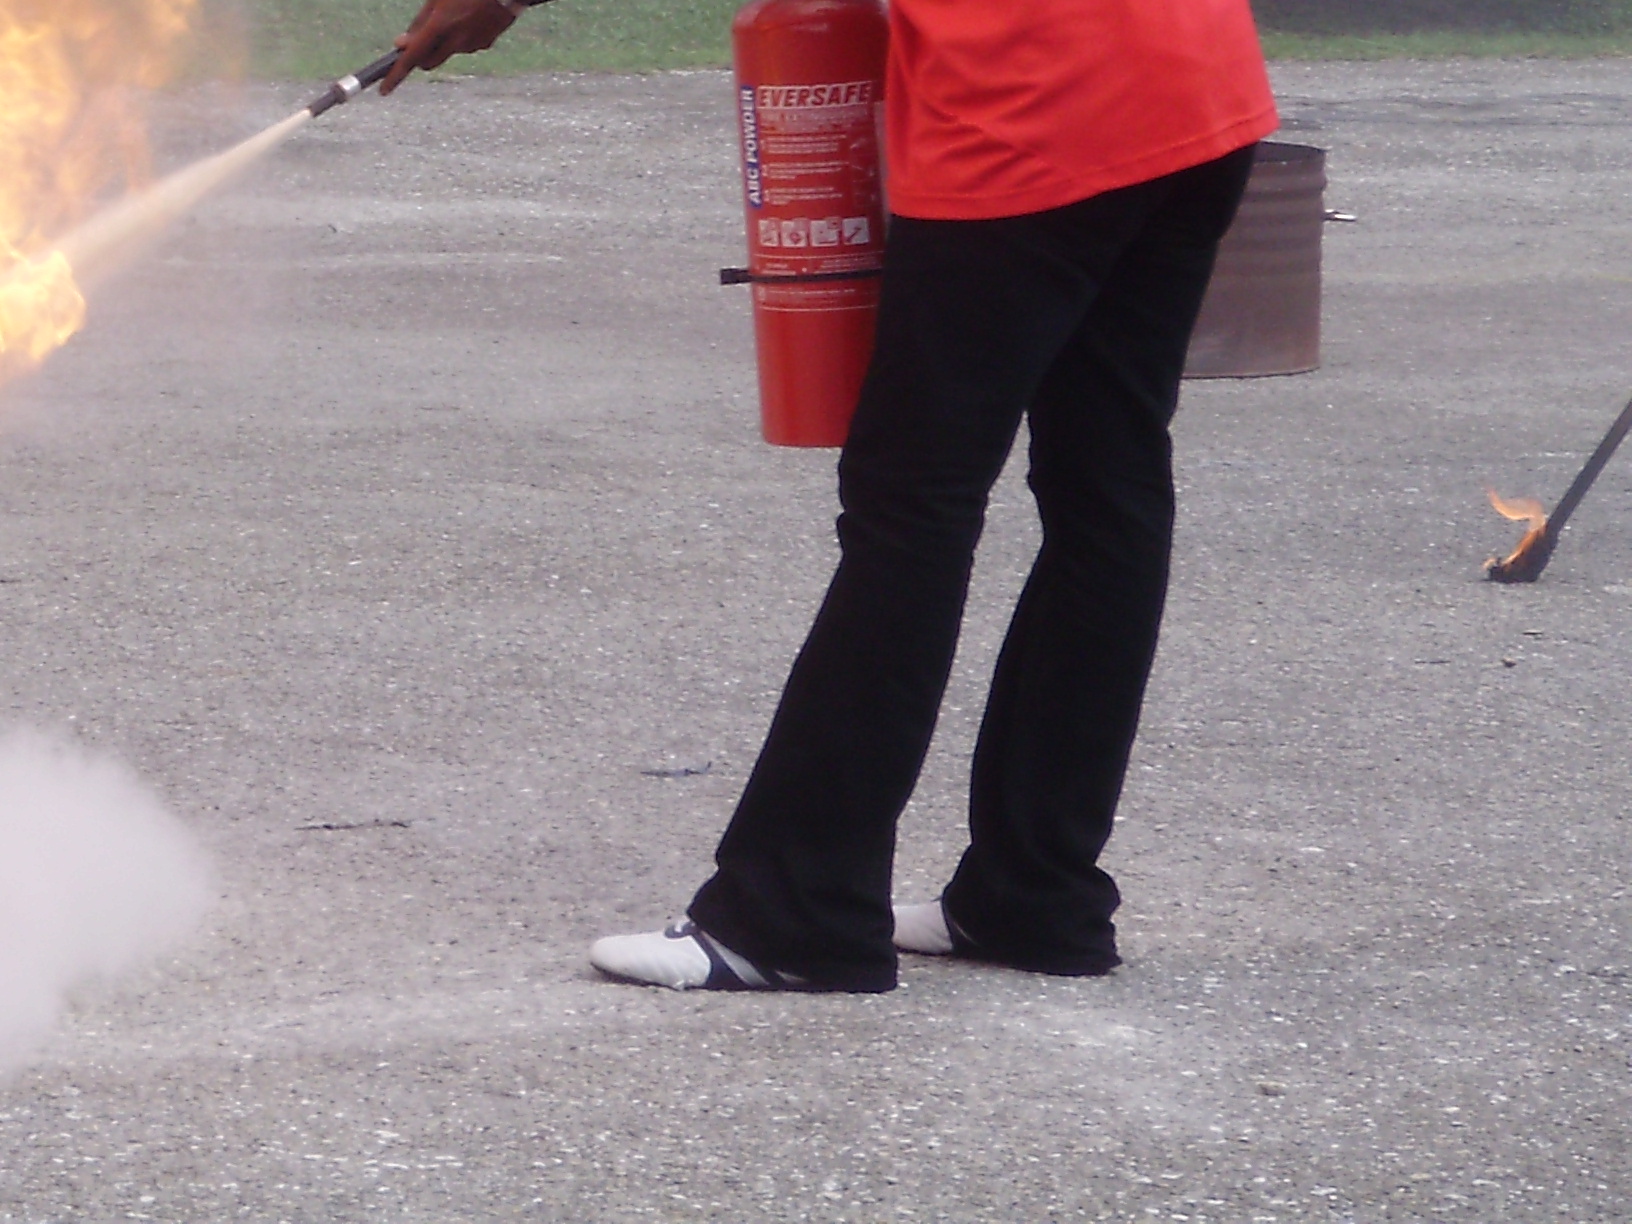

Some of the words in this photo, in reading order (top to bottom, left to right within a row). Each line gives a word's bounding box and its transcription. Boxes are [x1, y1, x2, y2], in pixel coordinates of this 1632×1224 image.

[758, 83, 871, 107] EVERSAFE
[741, 89, 758, 164] POWDER
[747, 168, 762, 204] ABC
